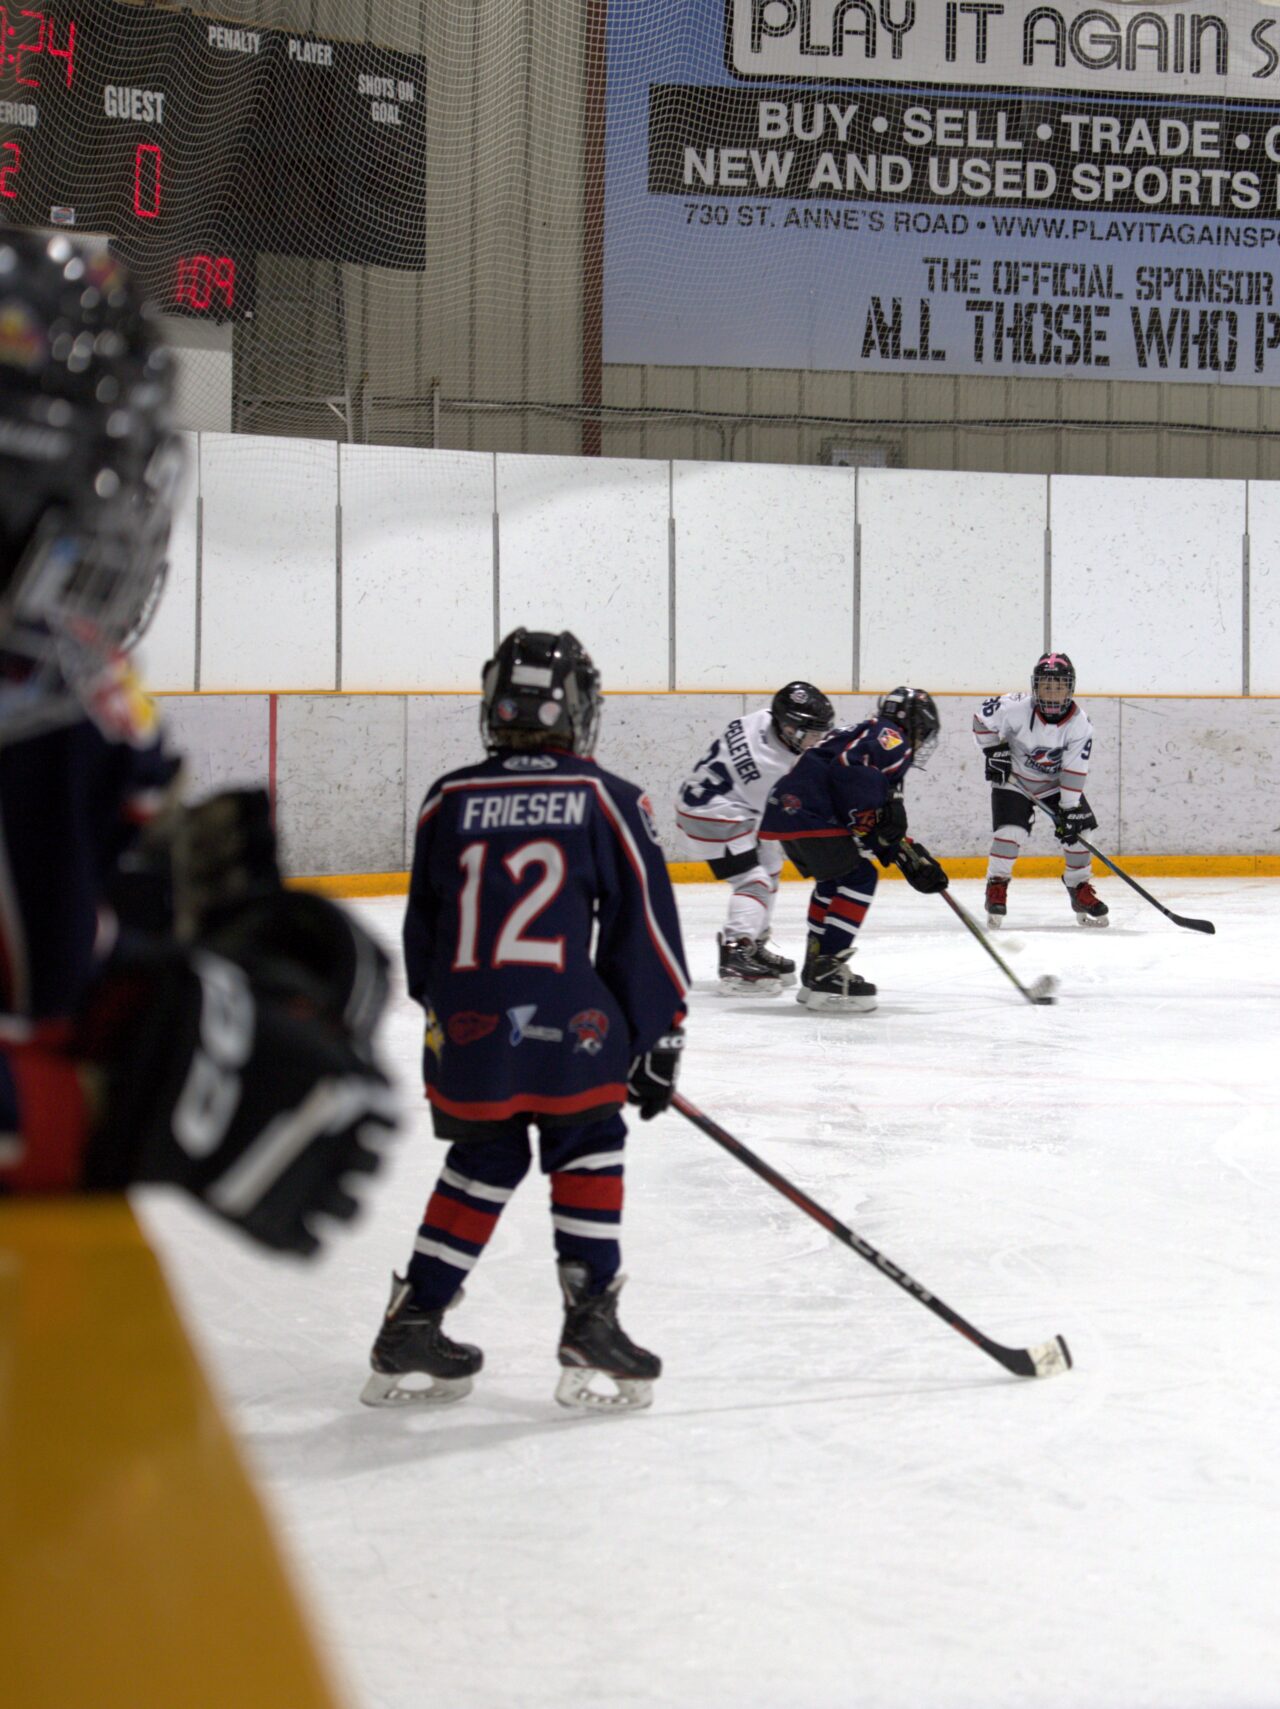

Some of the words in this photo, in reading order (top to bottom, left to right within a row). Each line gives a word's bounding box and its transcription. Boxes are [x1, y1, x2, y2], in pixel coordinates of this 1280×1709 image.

[208, 25, 261, 55] PENALTY
[288, 39, 333, 67] PLAYER
[751, 0, 915, 58] PLAY
[946, 2, 1004, 63] IT
[1023, 6, 1228, 75] AGAIN
[104, 84, 164, 125] GUEST
[358, 73, 395, 99] SHOTS
[0, 101, 37, 127] ERIOD
[371, 101, 401, 124] GOAL
[757, 101, 859, 142] BUY
[903, 107, 1023, 149] SELL
[1061, 114, 1222, 159] TRADE
[683, 147, 794, 189] NEW
[809, 153, 912, 194] AND
[929, 157, 1058, 200] USED
[1071, 163, 1261, 209] SPORTS
[683, 204, 730, 227] 730
[737, 206, 776, 229] ST.
[783, 208, 886, 233] ANNE'S
[894, 212, 970, 236] ROAD
[922, 257, 982, 295] THE
[991, 260, 1123, 300] OFFICIAL
[1135, 265, 1274, 307] SPONSOR
[860, 297, 946, 361] ALL
[966, 300, 1111, 367] THOSE
[1130, 305, 1238, 373] WHO
[724, 719, 762, 785] PELLETIER
[463, 793, 587, 830] FRIESEN
[450, 838, 567, 973] 12
